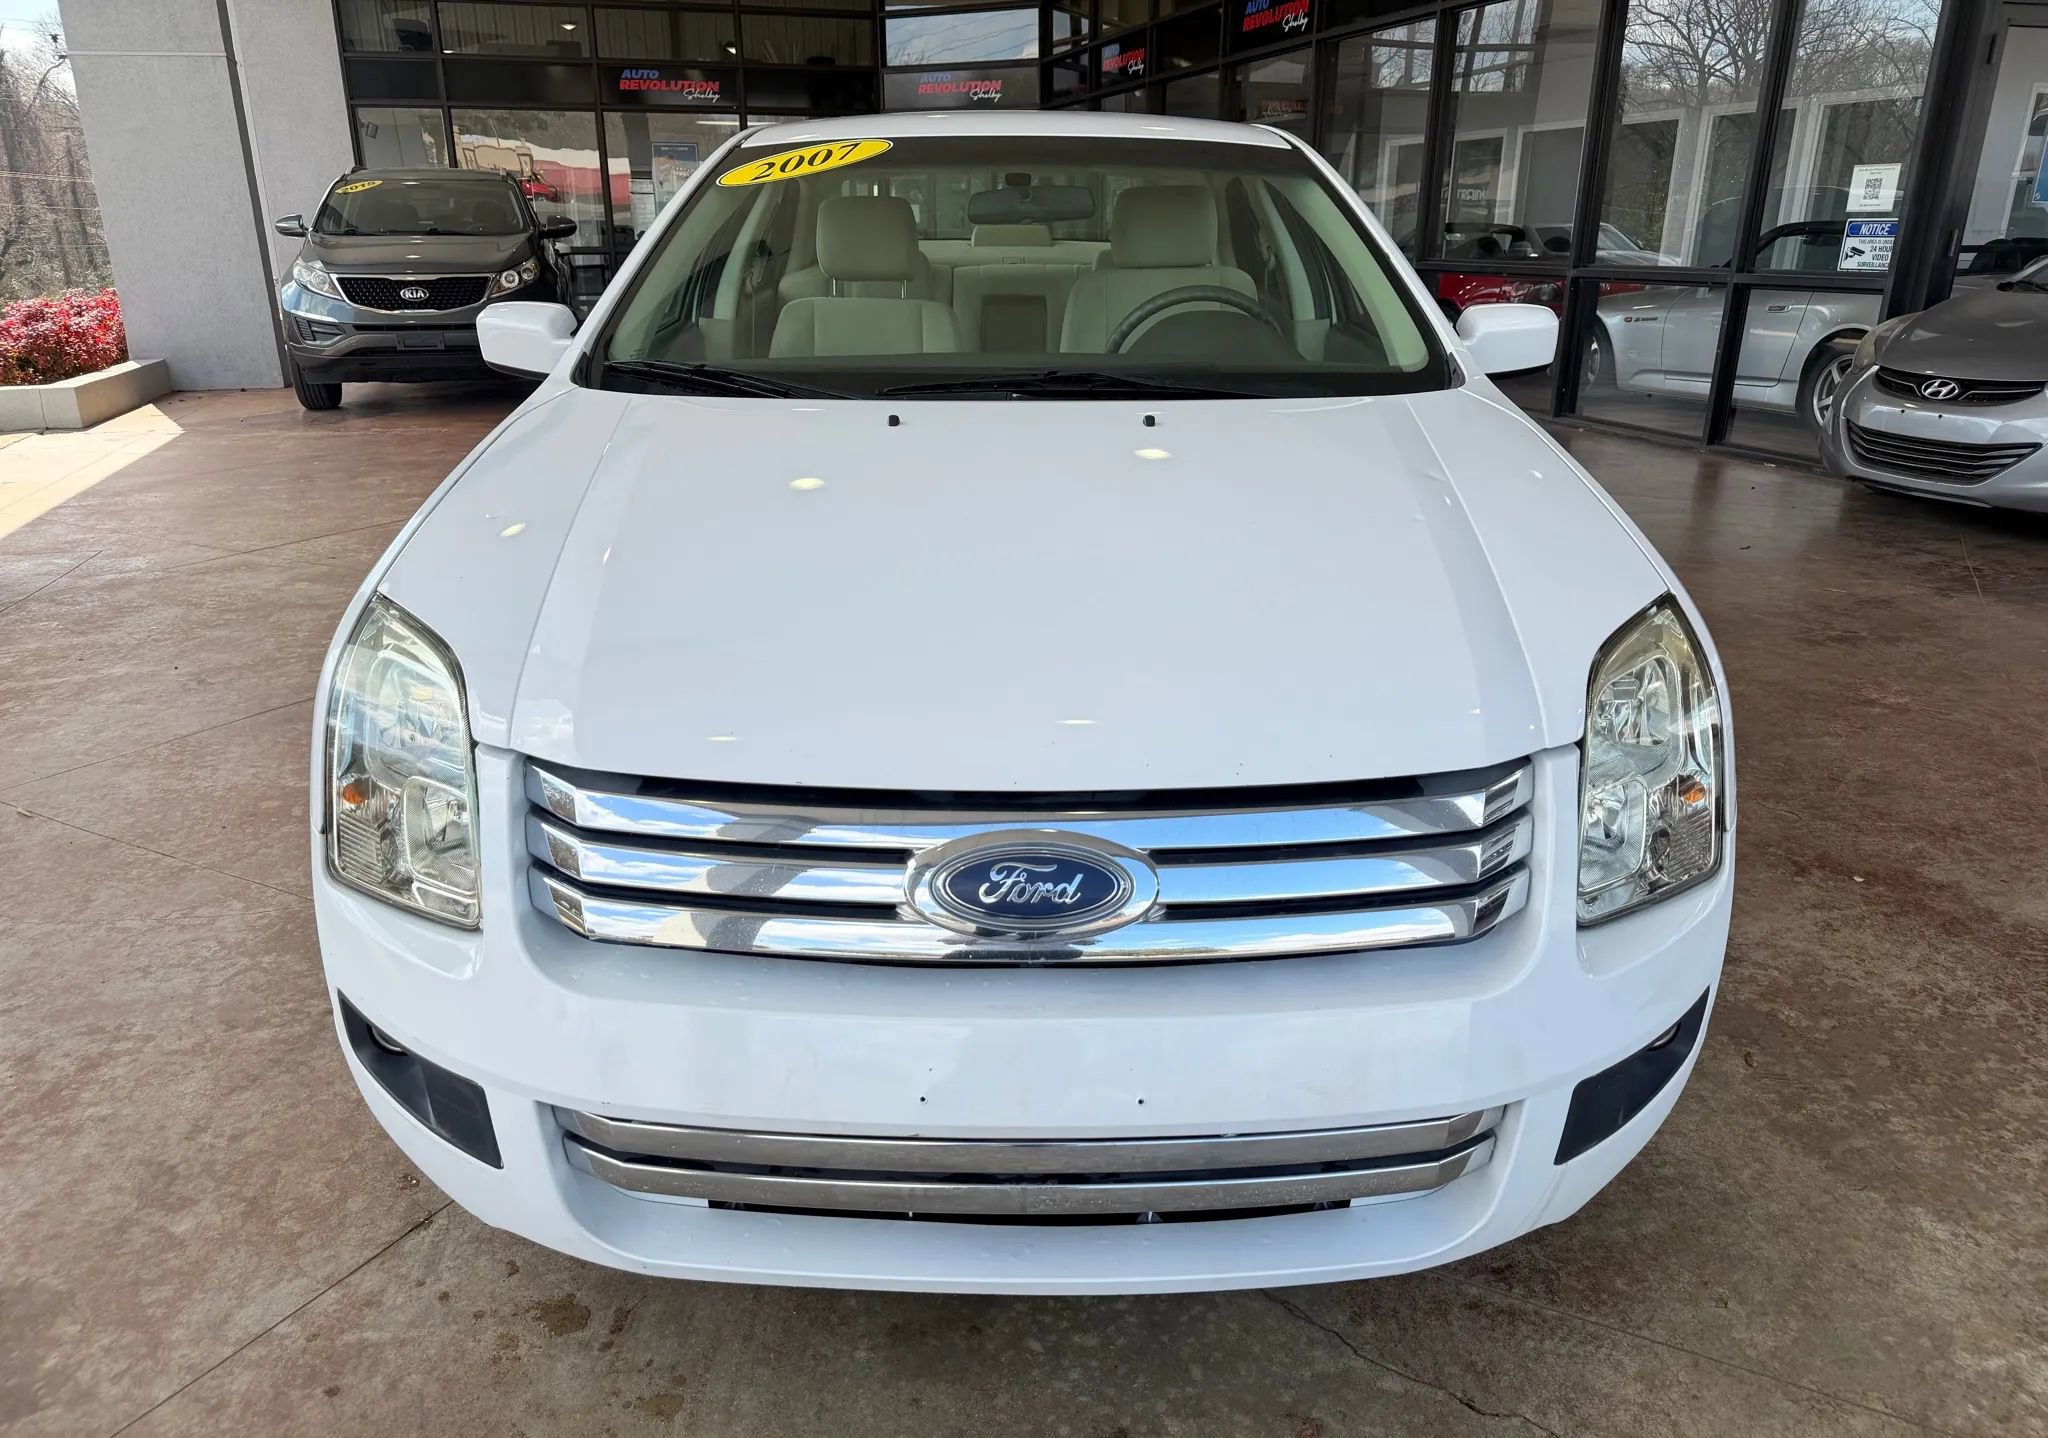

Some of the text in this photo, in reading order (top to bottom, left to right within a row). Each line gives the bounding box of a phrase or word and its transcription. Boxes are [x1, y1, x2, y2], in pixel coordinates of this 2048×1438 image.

[1245, 0, 1270, 15] AUTO
[1243, 0, 1309, 32] REVOLUTION
[1282, 9, 1309, 33] Shelby
[621, 68, 659, 79] AUTO
[920, 72, 951, 83] AUTO
[619, 79, 720, 92] REVOLUTION
[919, 79, 1002, 95] REVOLUTION
[682, 87, 721, 103] Shelby
[969, 87, 1003, 103] Shelby
[750, 143, 862, 181] 2007
[1859, 223, 1892, 235] NOTICE
[1869, 245, 1878, 253] 24
[1871, 253, 1889, 261] VIDEO
[979, 861, 1084, 904] Ford
